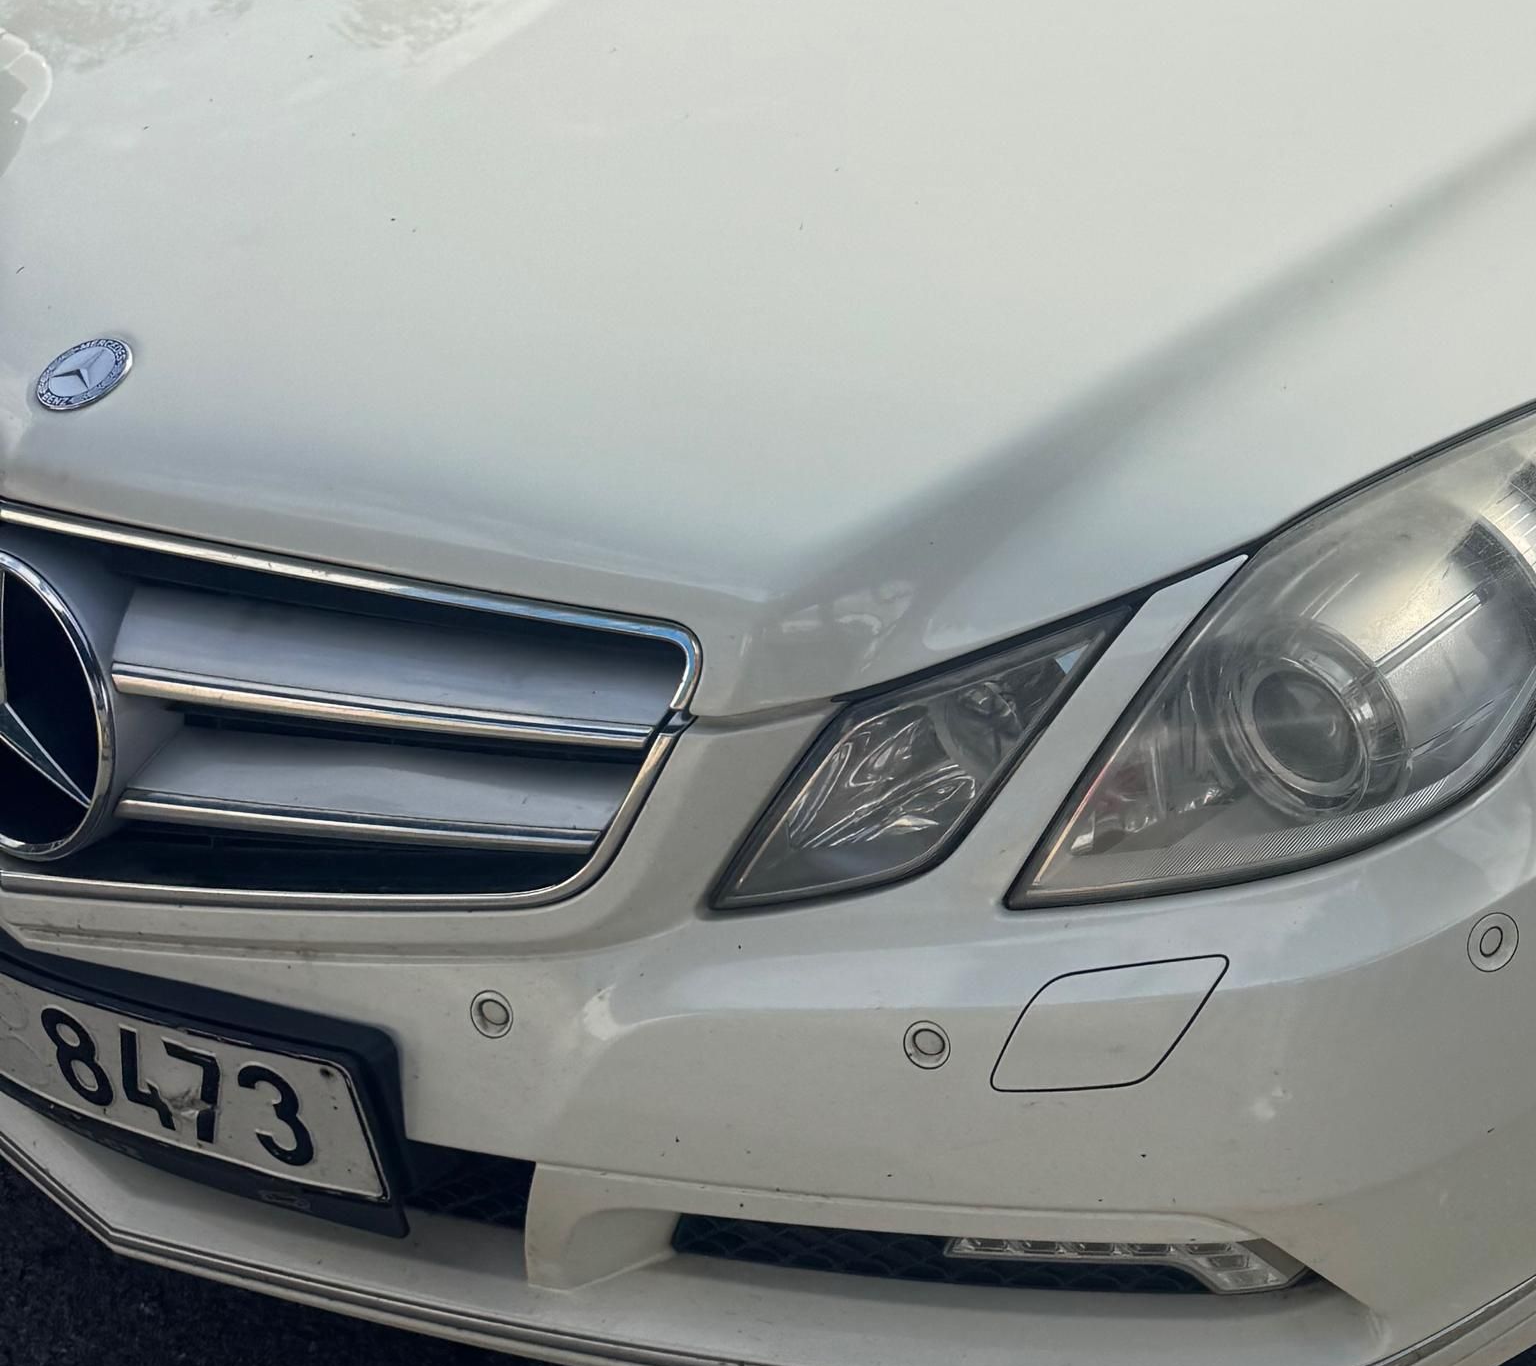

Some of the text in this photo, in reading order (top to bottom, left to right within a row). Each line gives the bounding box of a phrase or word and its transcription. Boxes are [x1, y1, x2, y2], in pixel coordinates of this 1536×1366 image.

[80, 339, 126, 364] MERCEDES
[42, 392, 71, 406] BENZ
[41, 1006, 314, 1167] 8473
